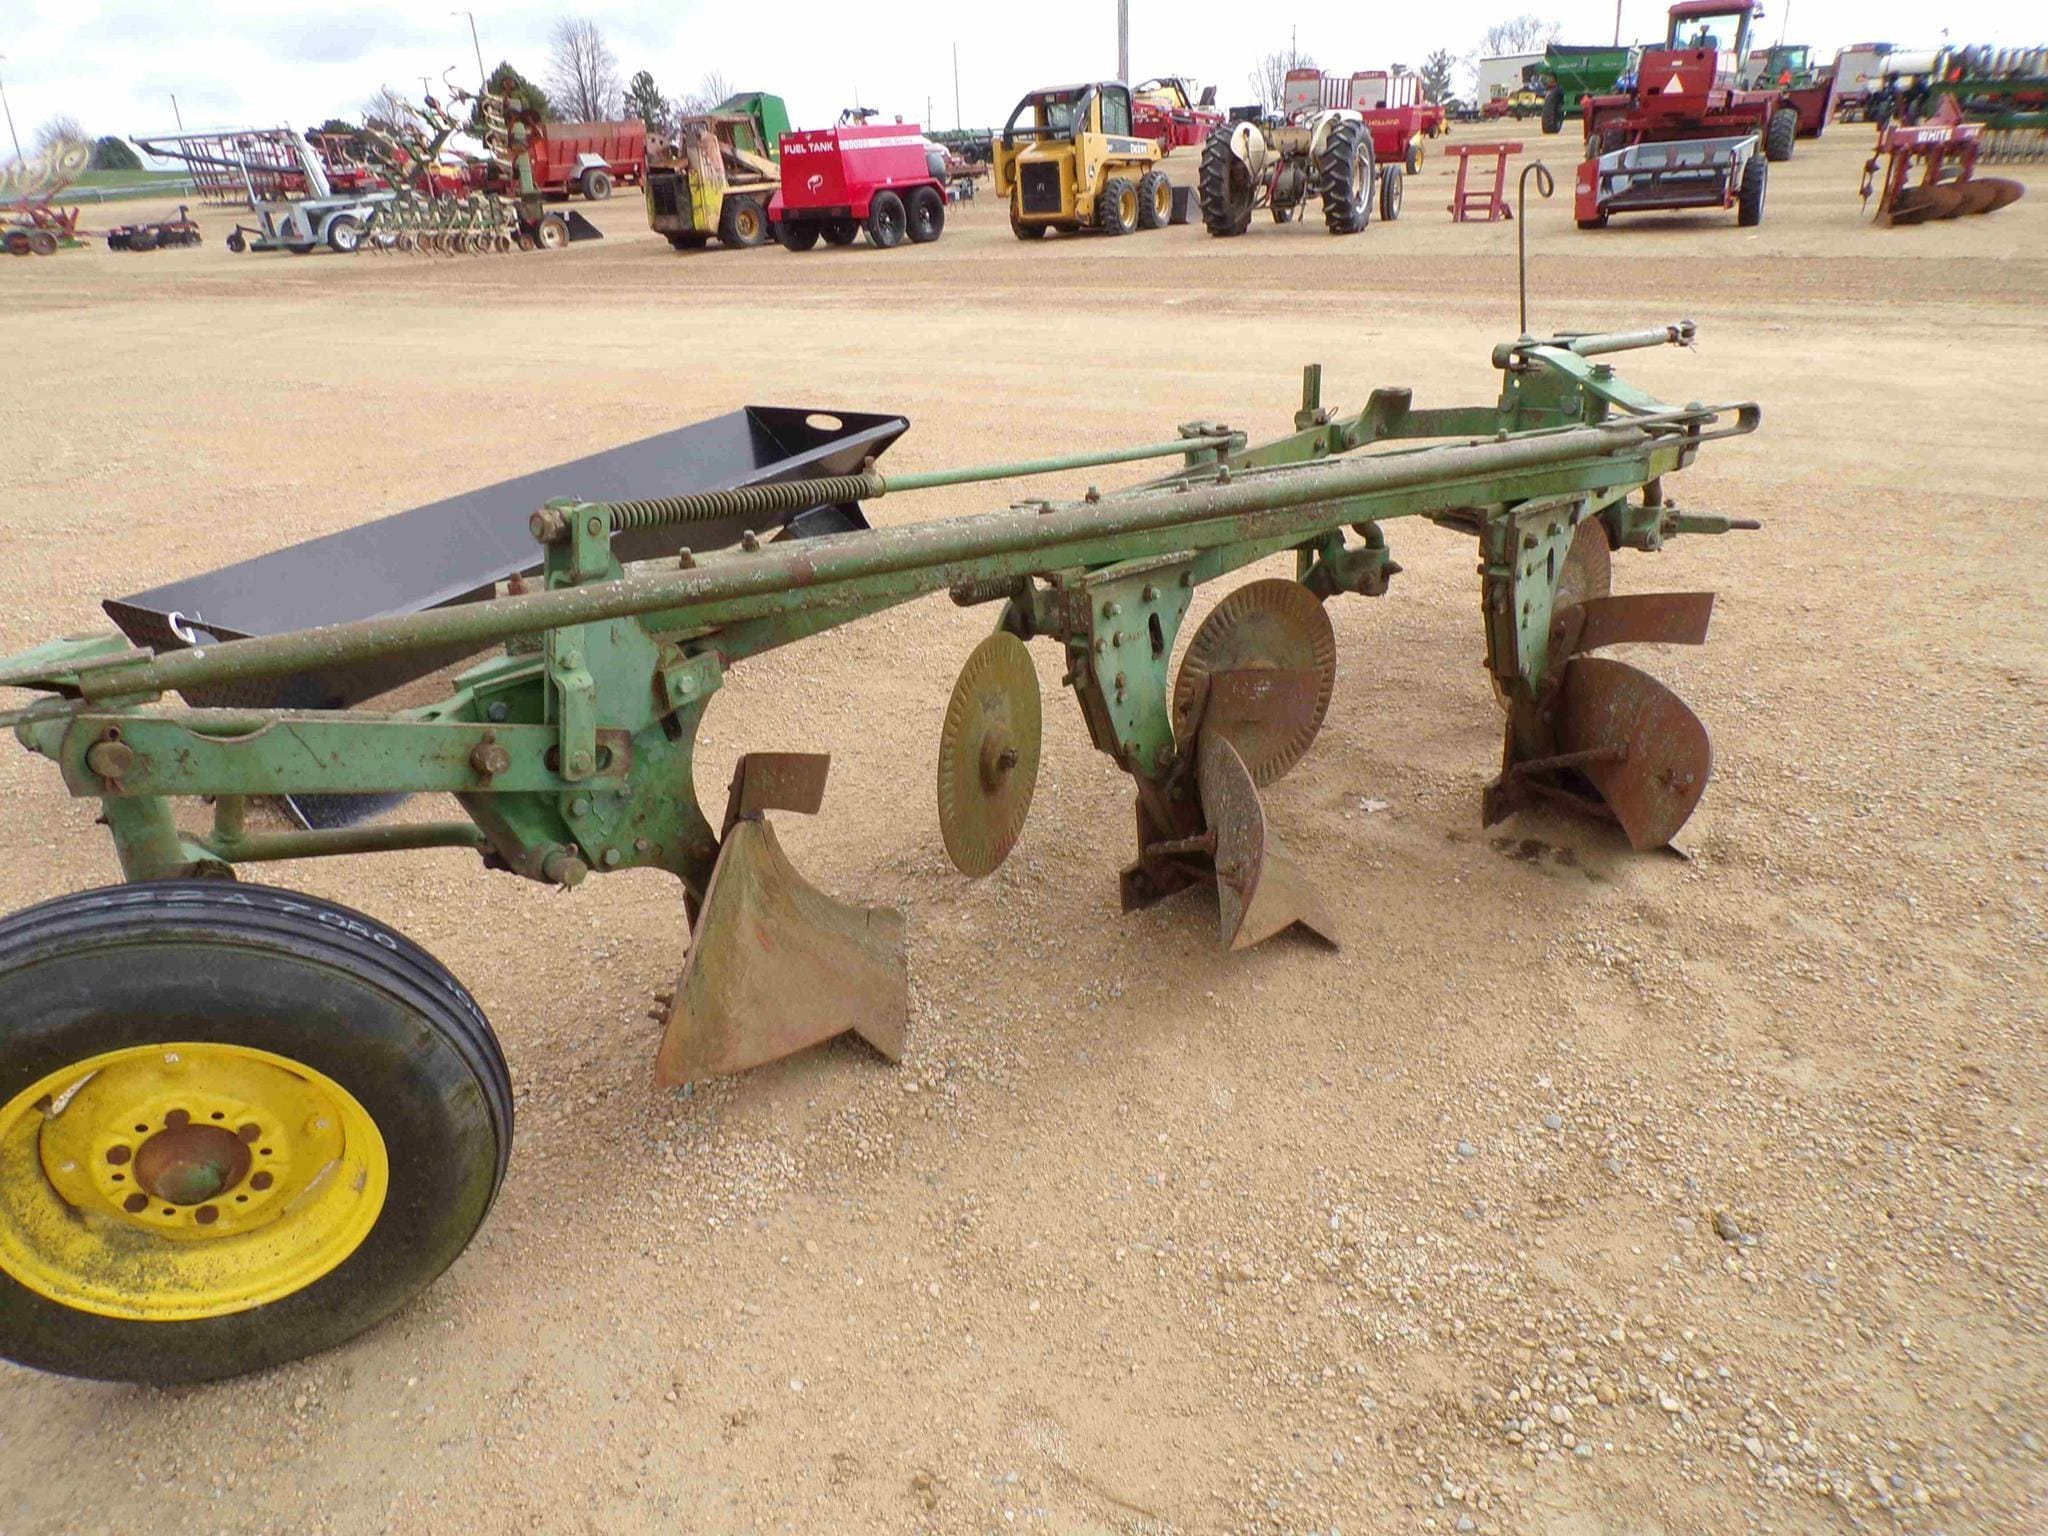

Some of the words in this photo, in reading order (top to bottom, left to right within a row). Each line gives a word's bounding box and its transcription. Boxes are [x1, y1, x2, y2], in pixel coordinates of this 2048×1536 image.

[1917, 128, 1952, 143] WHITE
[784, 143, 807, 155] FUEL
[807, 141, 834, 153] TANK
